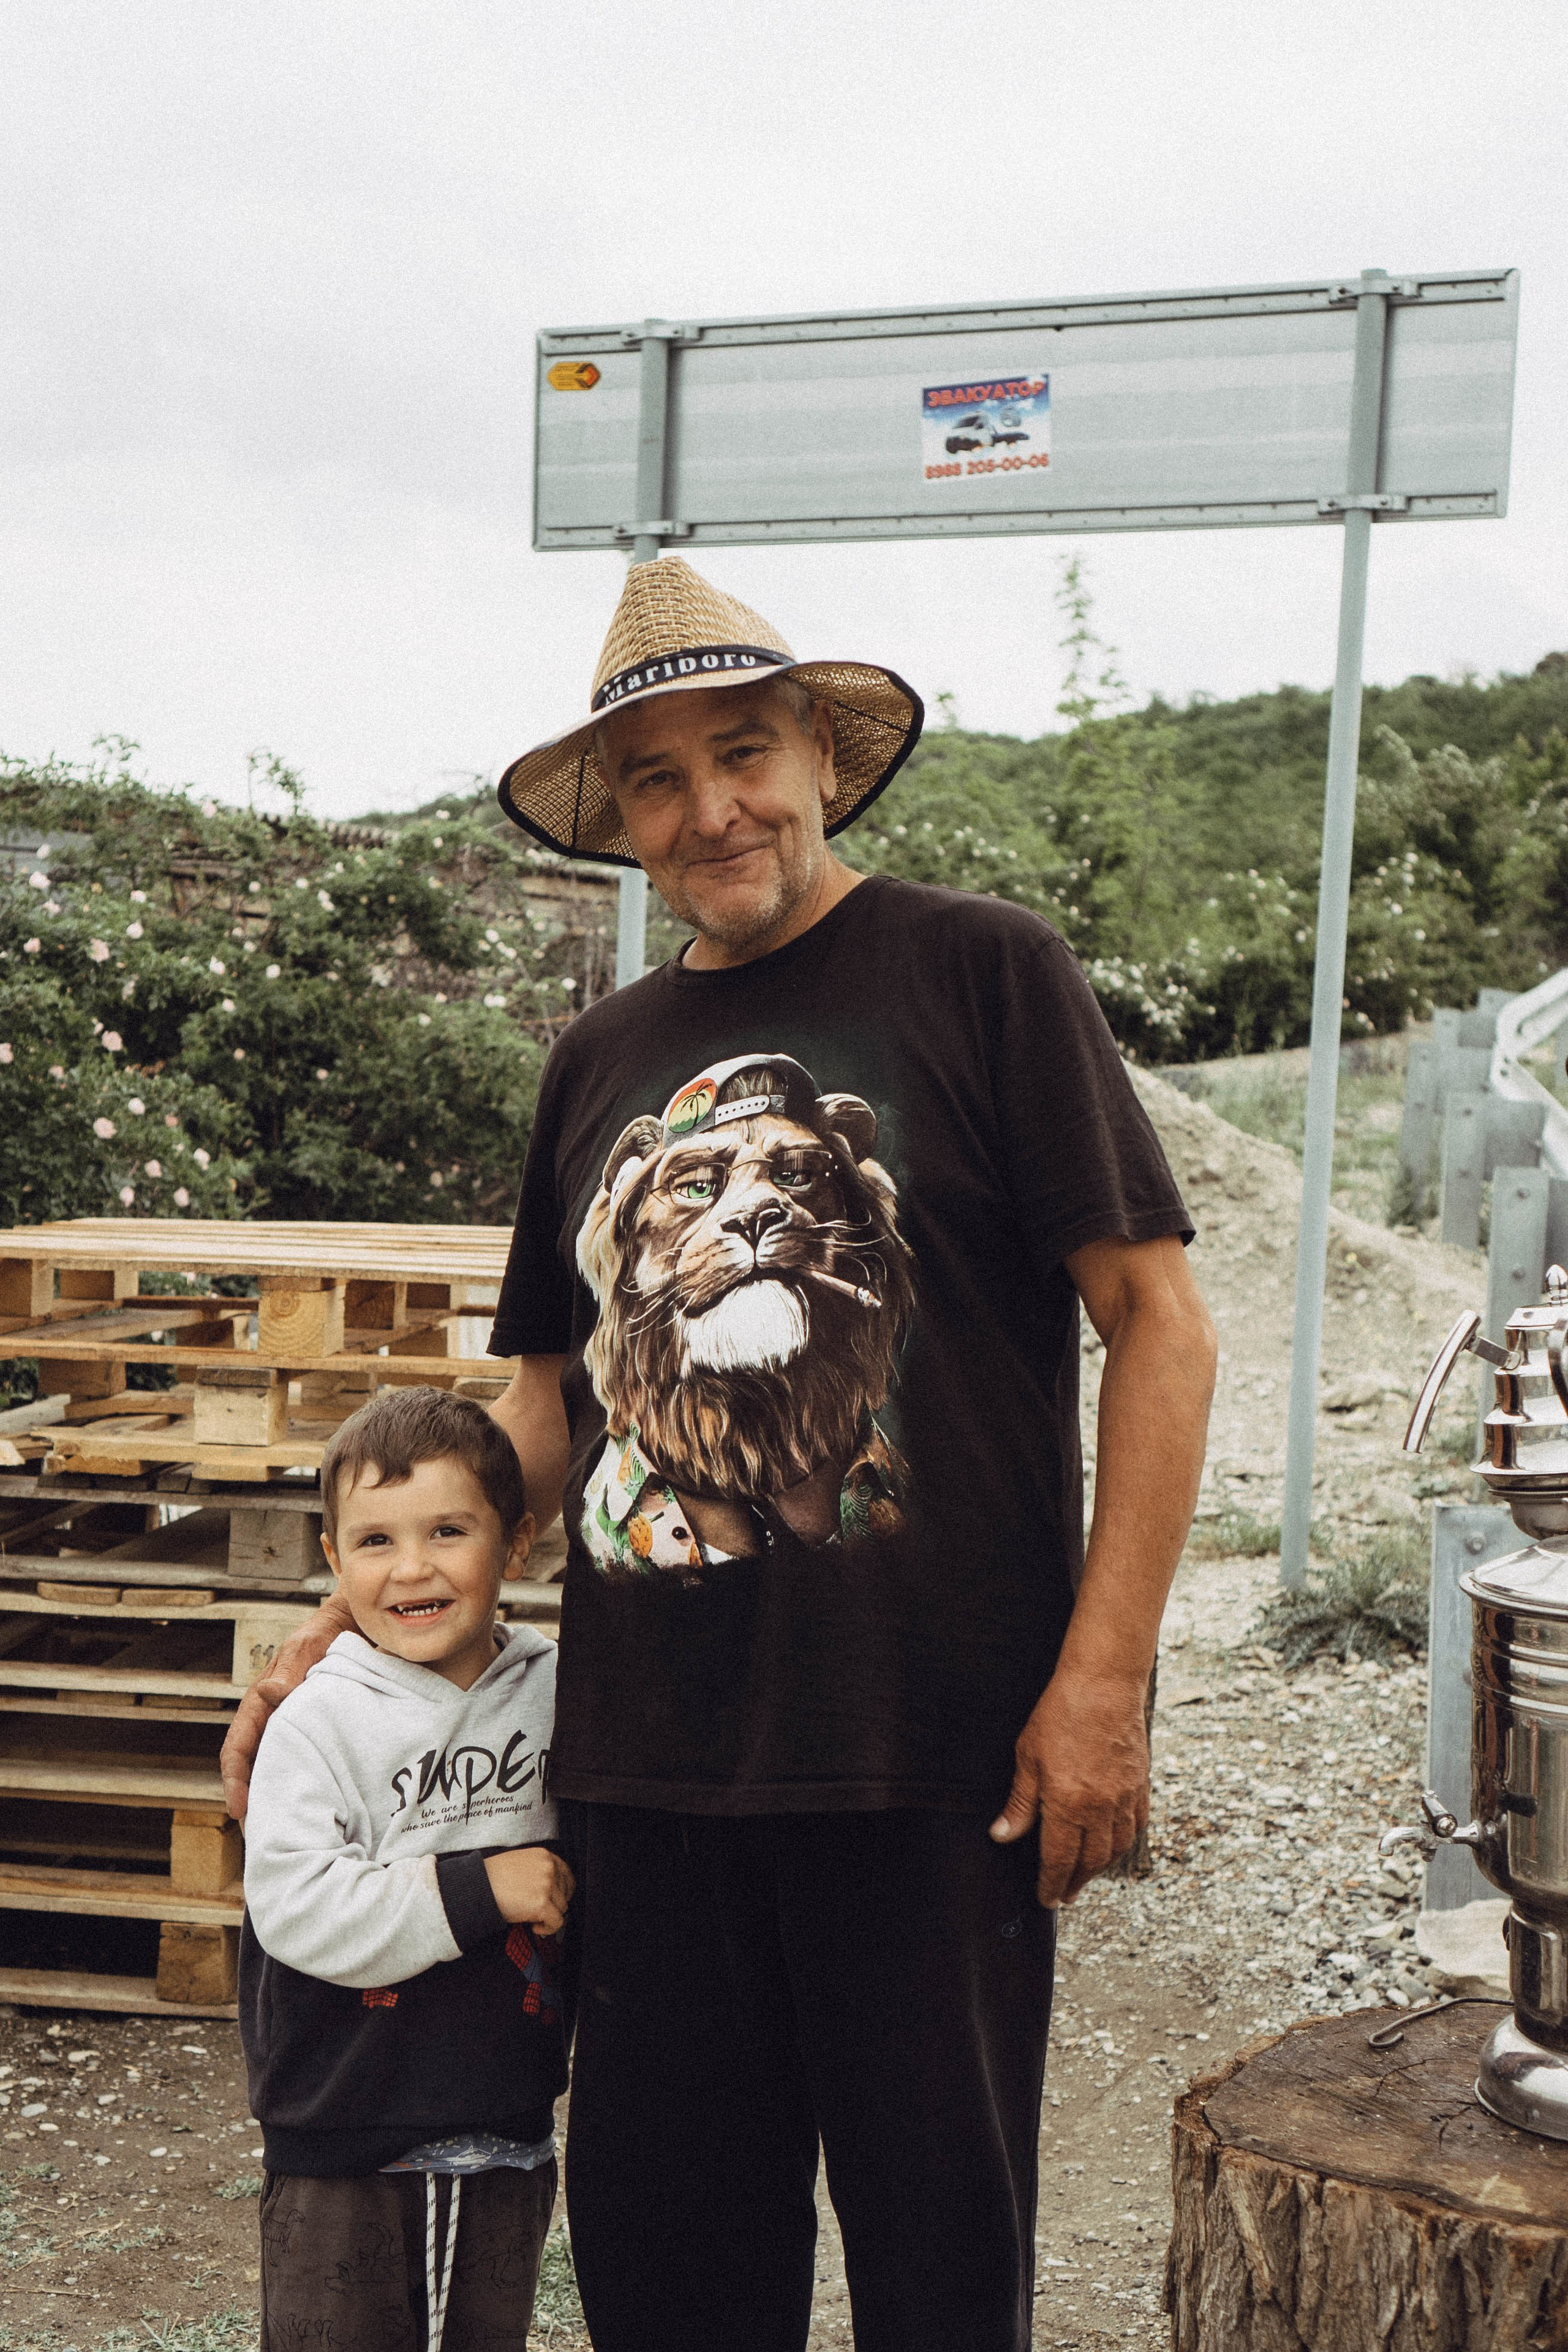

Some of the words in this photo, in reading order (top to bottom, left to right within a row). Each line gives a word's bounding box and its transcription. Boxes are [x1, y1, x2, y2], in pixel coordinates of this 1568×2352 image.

[927, 380, 1046, 407] ЭВАКУАТОР
[421, 1809, 435, 1818] We
[443, 1814, 458, 1824] the
[484, 1807, 493, 1817] of
